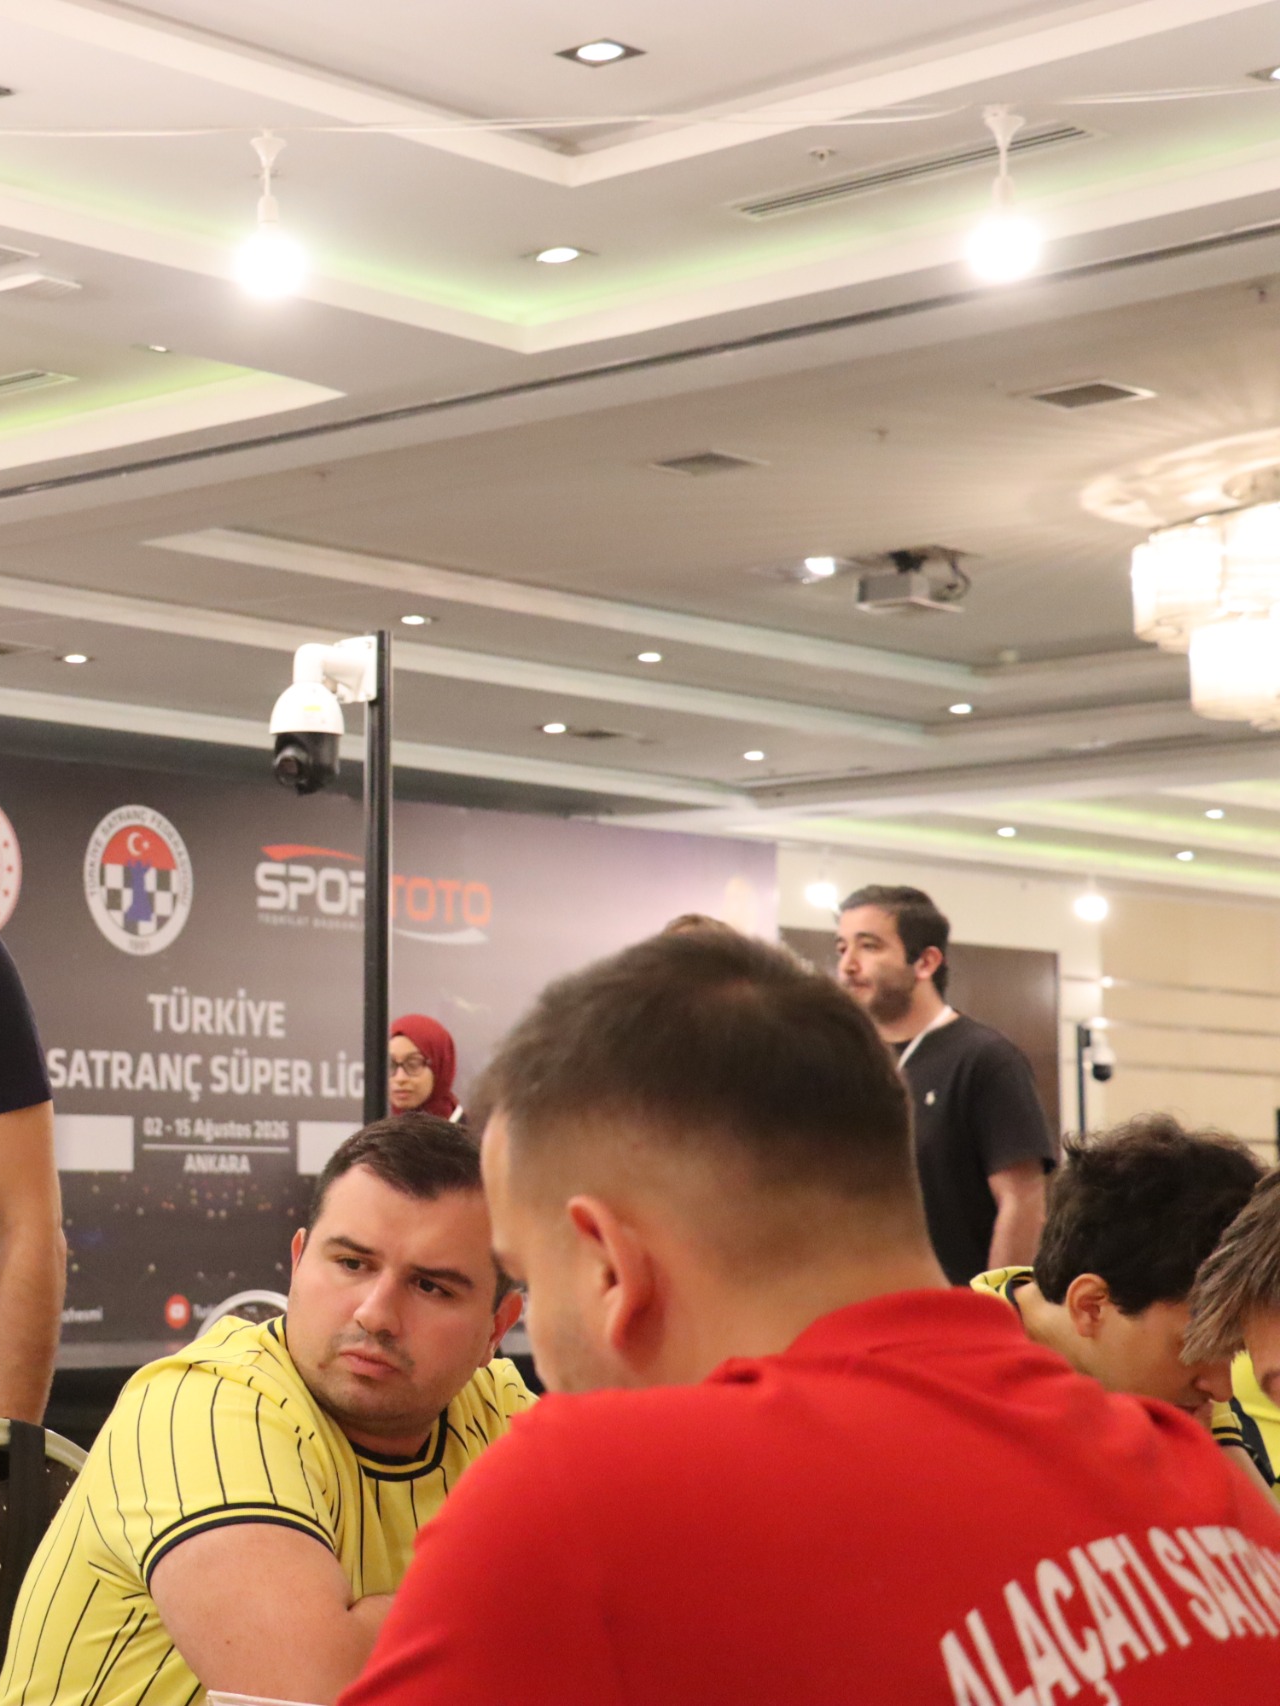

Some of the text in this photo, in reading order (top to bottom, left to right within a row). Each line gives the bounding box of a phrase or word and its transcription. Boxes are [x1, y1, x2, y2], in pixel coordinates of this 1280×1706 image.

[146, 986, 286, 1038] TÜRKİYE
[46, 1046, 365, 1102] SATRANÇ SÜPER LİG
[143, 1116, 164, 1137] 02
[174, 1117, 192, 1138] 15
[193, 1116, 252, 1143] Ağustos
[183, 1152, 251, 1174] ANKARA
[940, 1532, 1192, 1706] ALAÇATI
